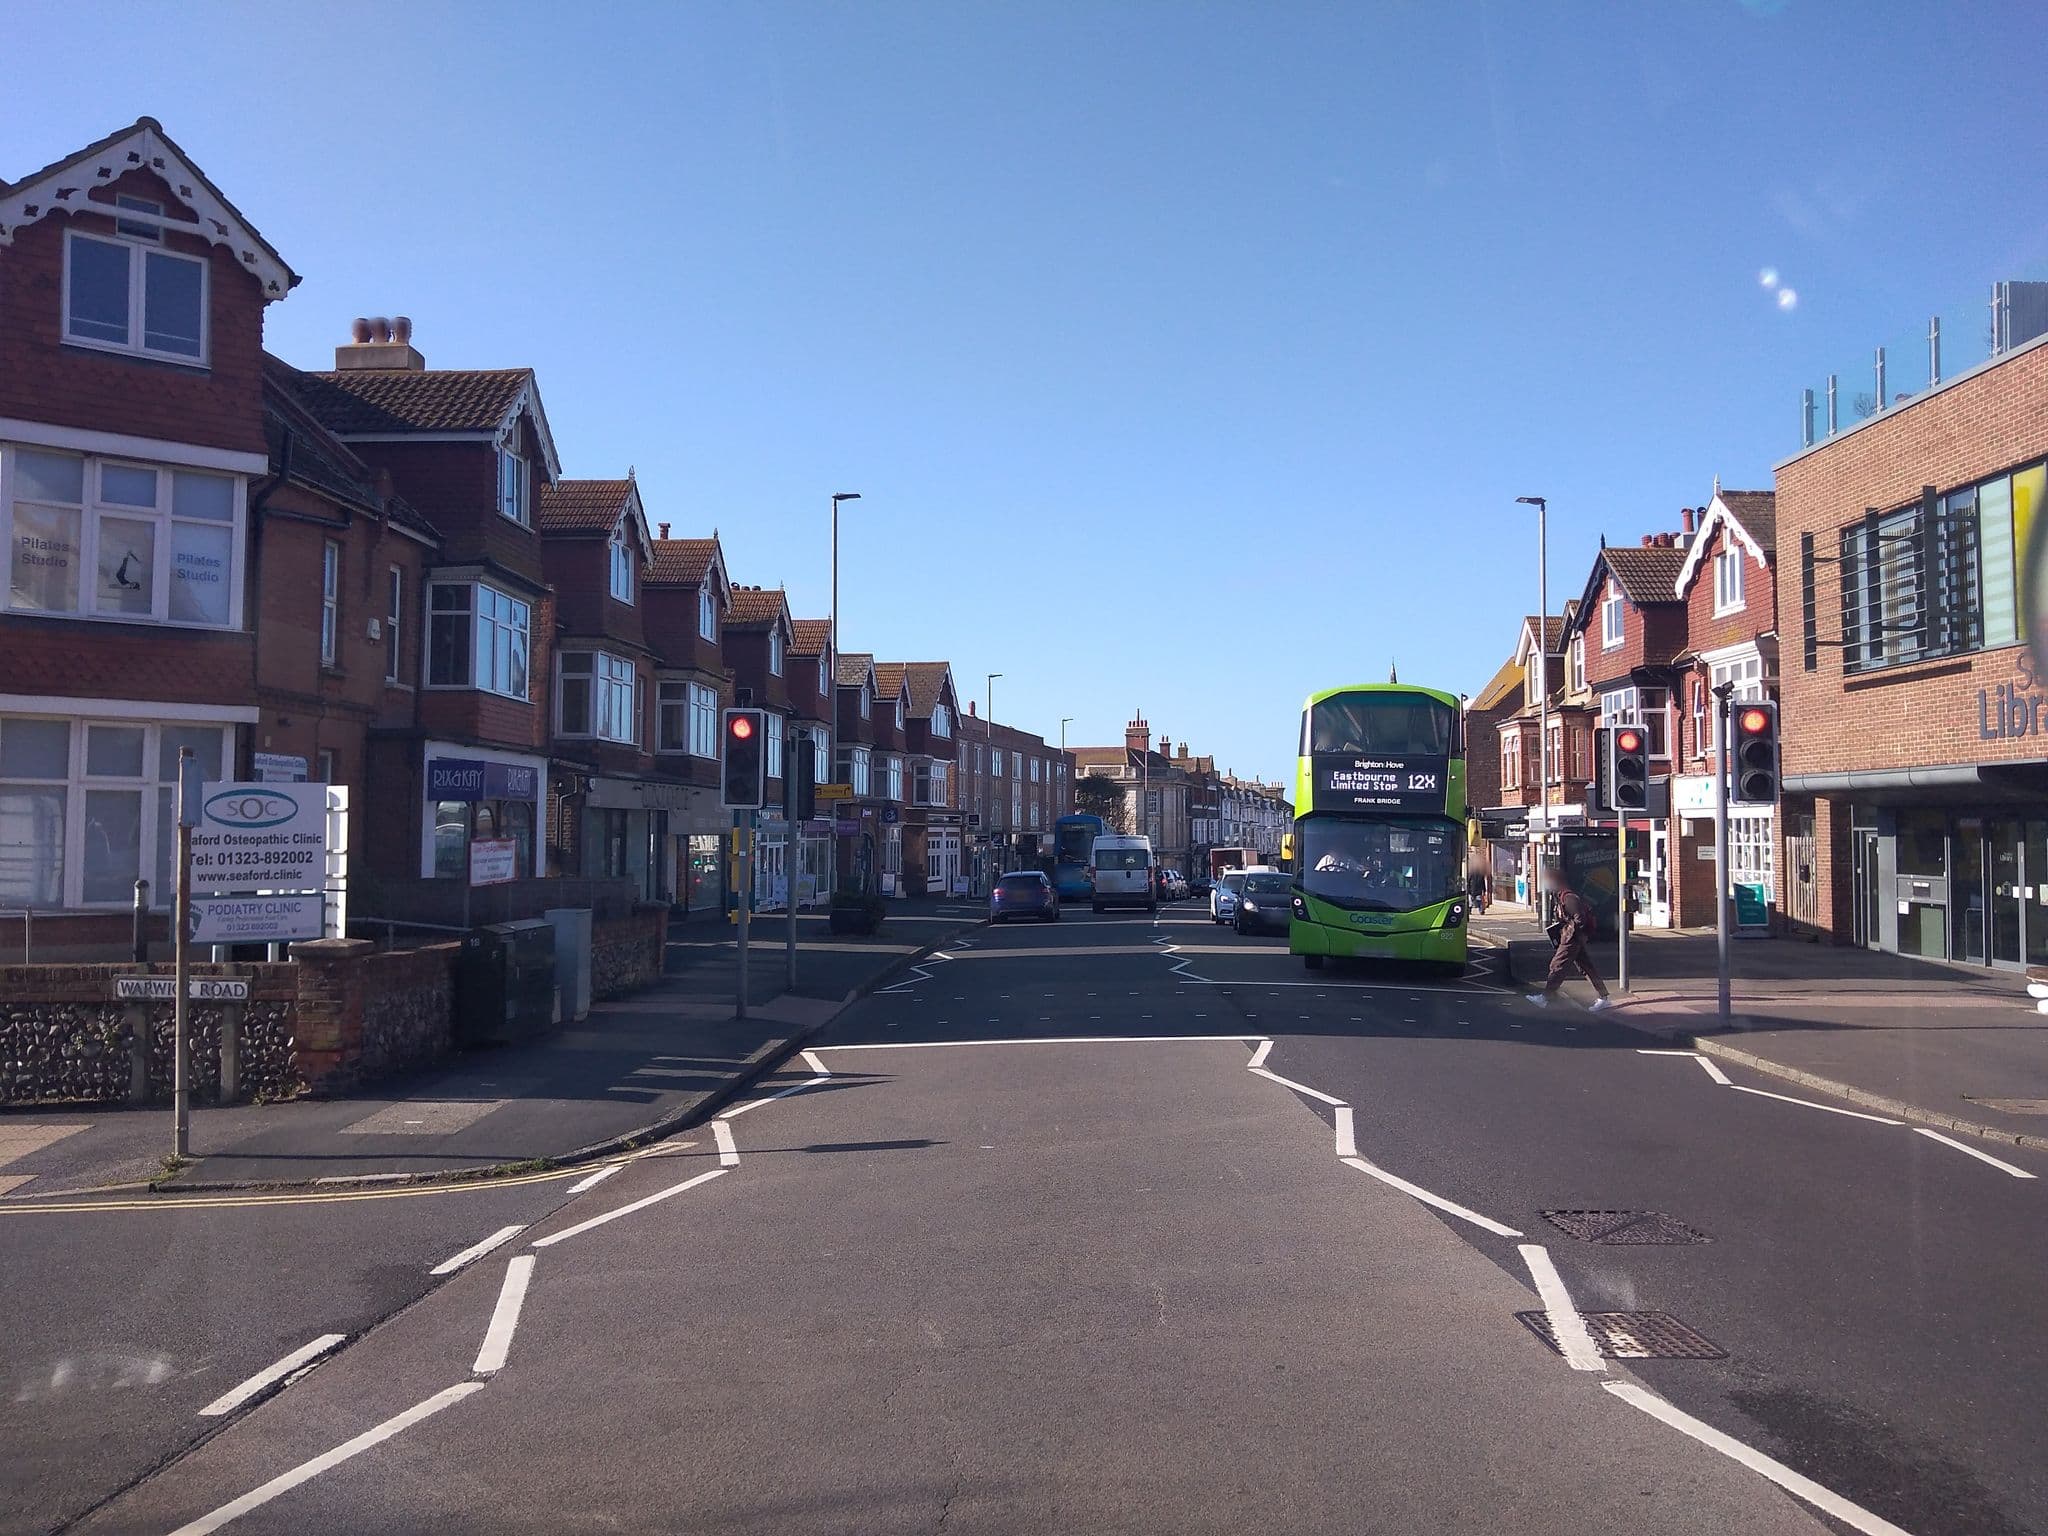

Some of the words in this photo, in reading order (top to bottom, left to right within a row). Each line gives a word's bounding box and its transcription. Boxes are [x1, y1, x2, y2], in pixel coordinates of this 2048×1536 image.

[20, 536, 71, 552] Pilates
[20, 553, 68, 568] Studio
[176, 552, 221, 568] Pilates
[176, 568, 220, 583] Studio
[1354, 759, 1384, 770] Brighton
[1385, 761, 1404, 769] Hove
[1333, 771, 1396, 782] Eastbourne
[1408, 774, 1436, 790] 12X
[1330, 780, 1370, 791] Limited
[1373, 781, 1399, 791] Stop
[1354, 797, 1376, 805] FRANK
[1376, 797, 1402, 805] BRIDGE
[226, 798, 279, 820] SOC
[223, 833, 289, 847] Osteopathic
[292, 832, 322, 844] Clinic
[217, 850, 313, 866] 01323-892002
[197, 869, 302, 882] www.seaford.clinic
[207, 904, 264, 916] PODIATRY
[264, 902, 302, 914] CLINIC
[1349, 912, 1394, 926] Coaster
[200, 982, 246, 998] ROAD
